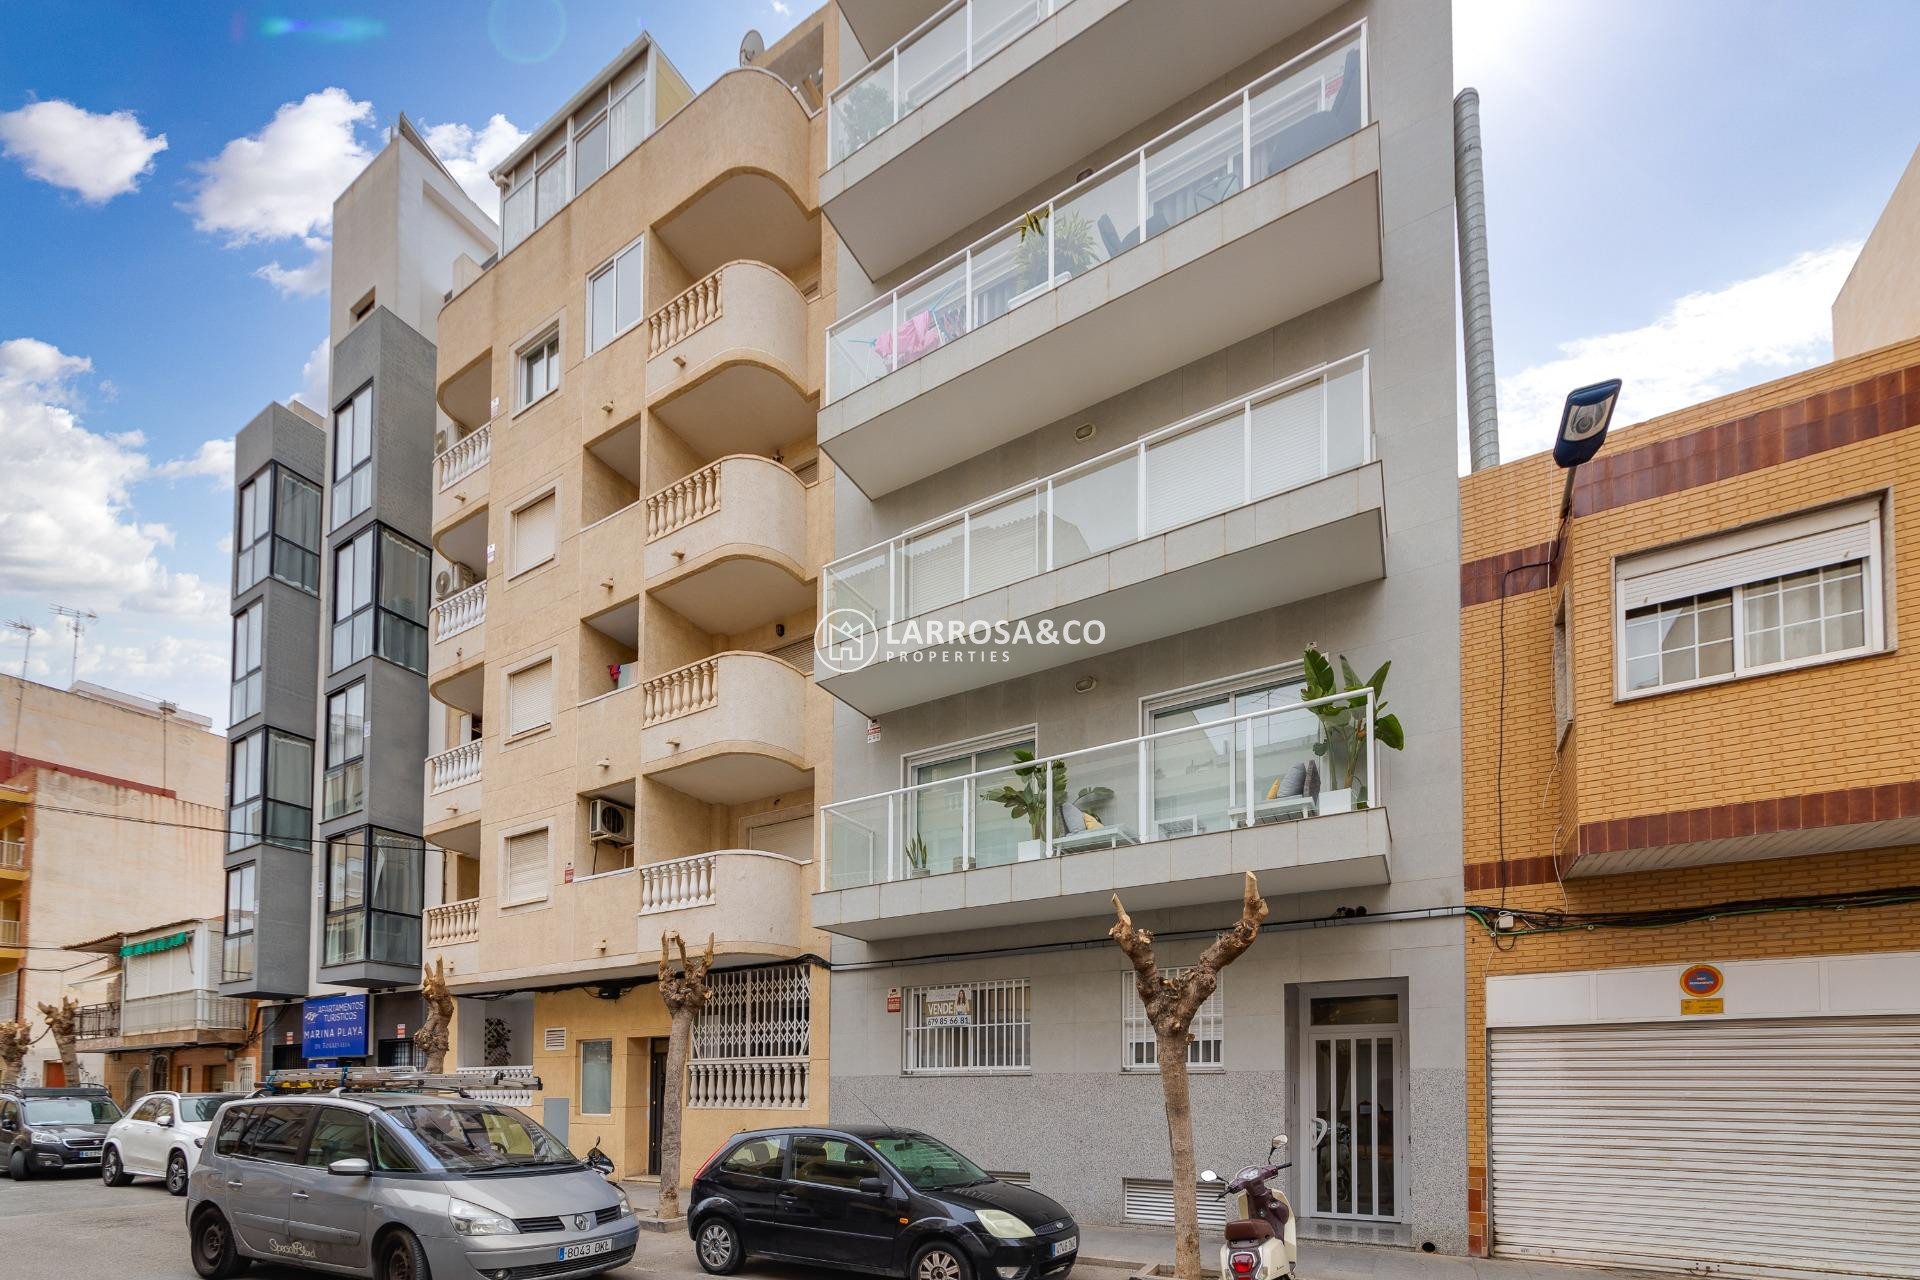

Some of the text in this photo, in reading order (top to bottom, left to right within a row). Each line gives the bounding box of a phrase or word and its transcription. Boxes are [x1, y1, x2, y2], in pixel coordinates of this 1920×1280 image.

[318, 1001, 364, 1013] APARTAMENTOS
[940, 1017, 948, 1025] 85
[304, 1028, 335, 1039] MARINA
[337, 1026, 364, 1037] PLAYA
[567, 1244, 591, 1258] 8043
